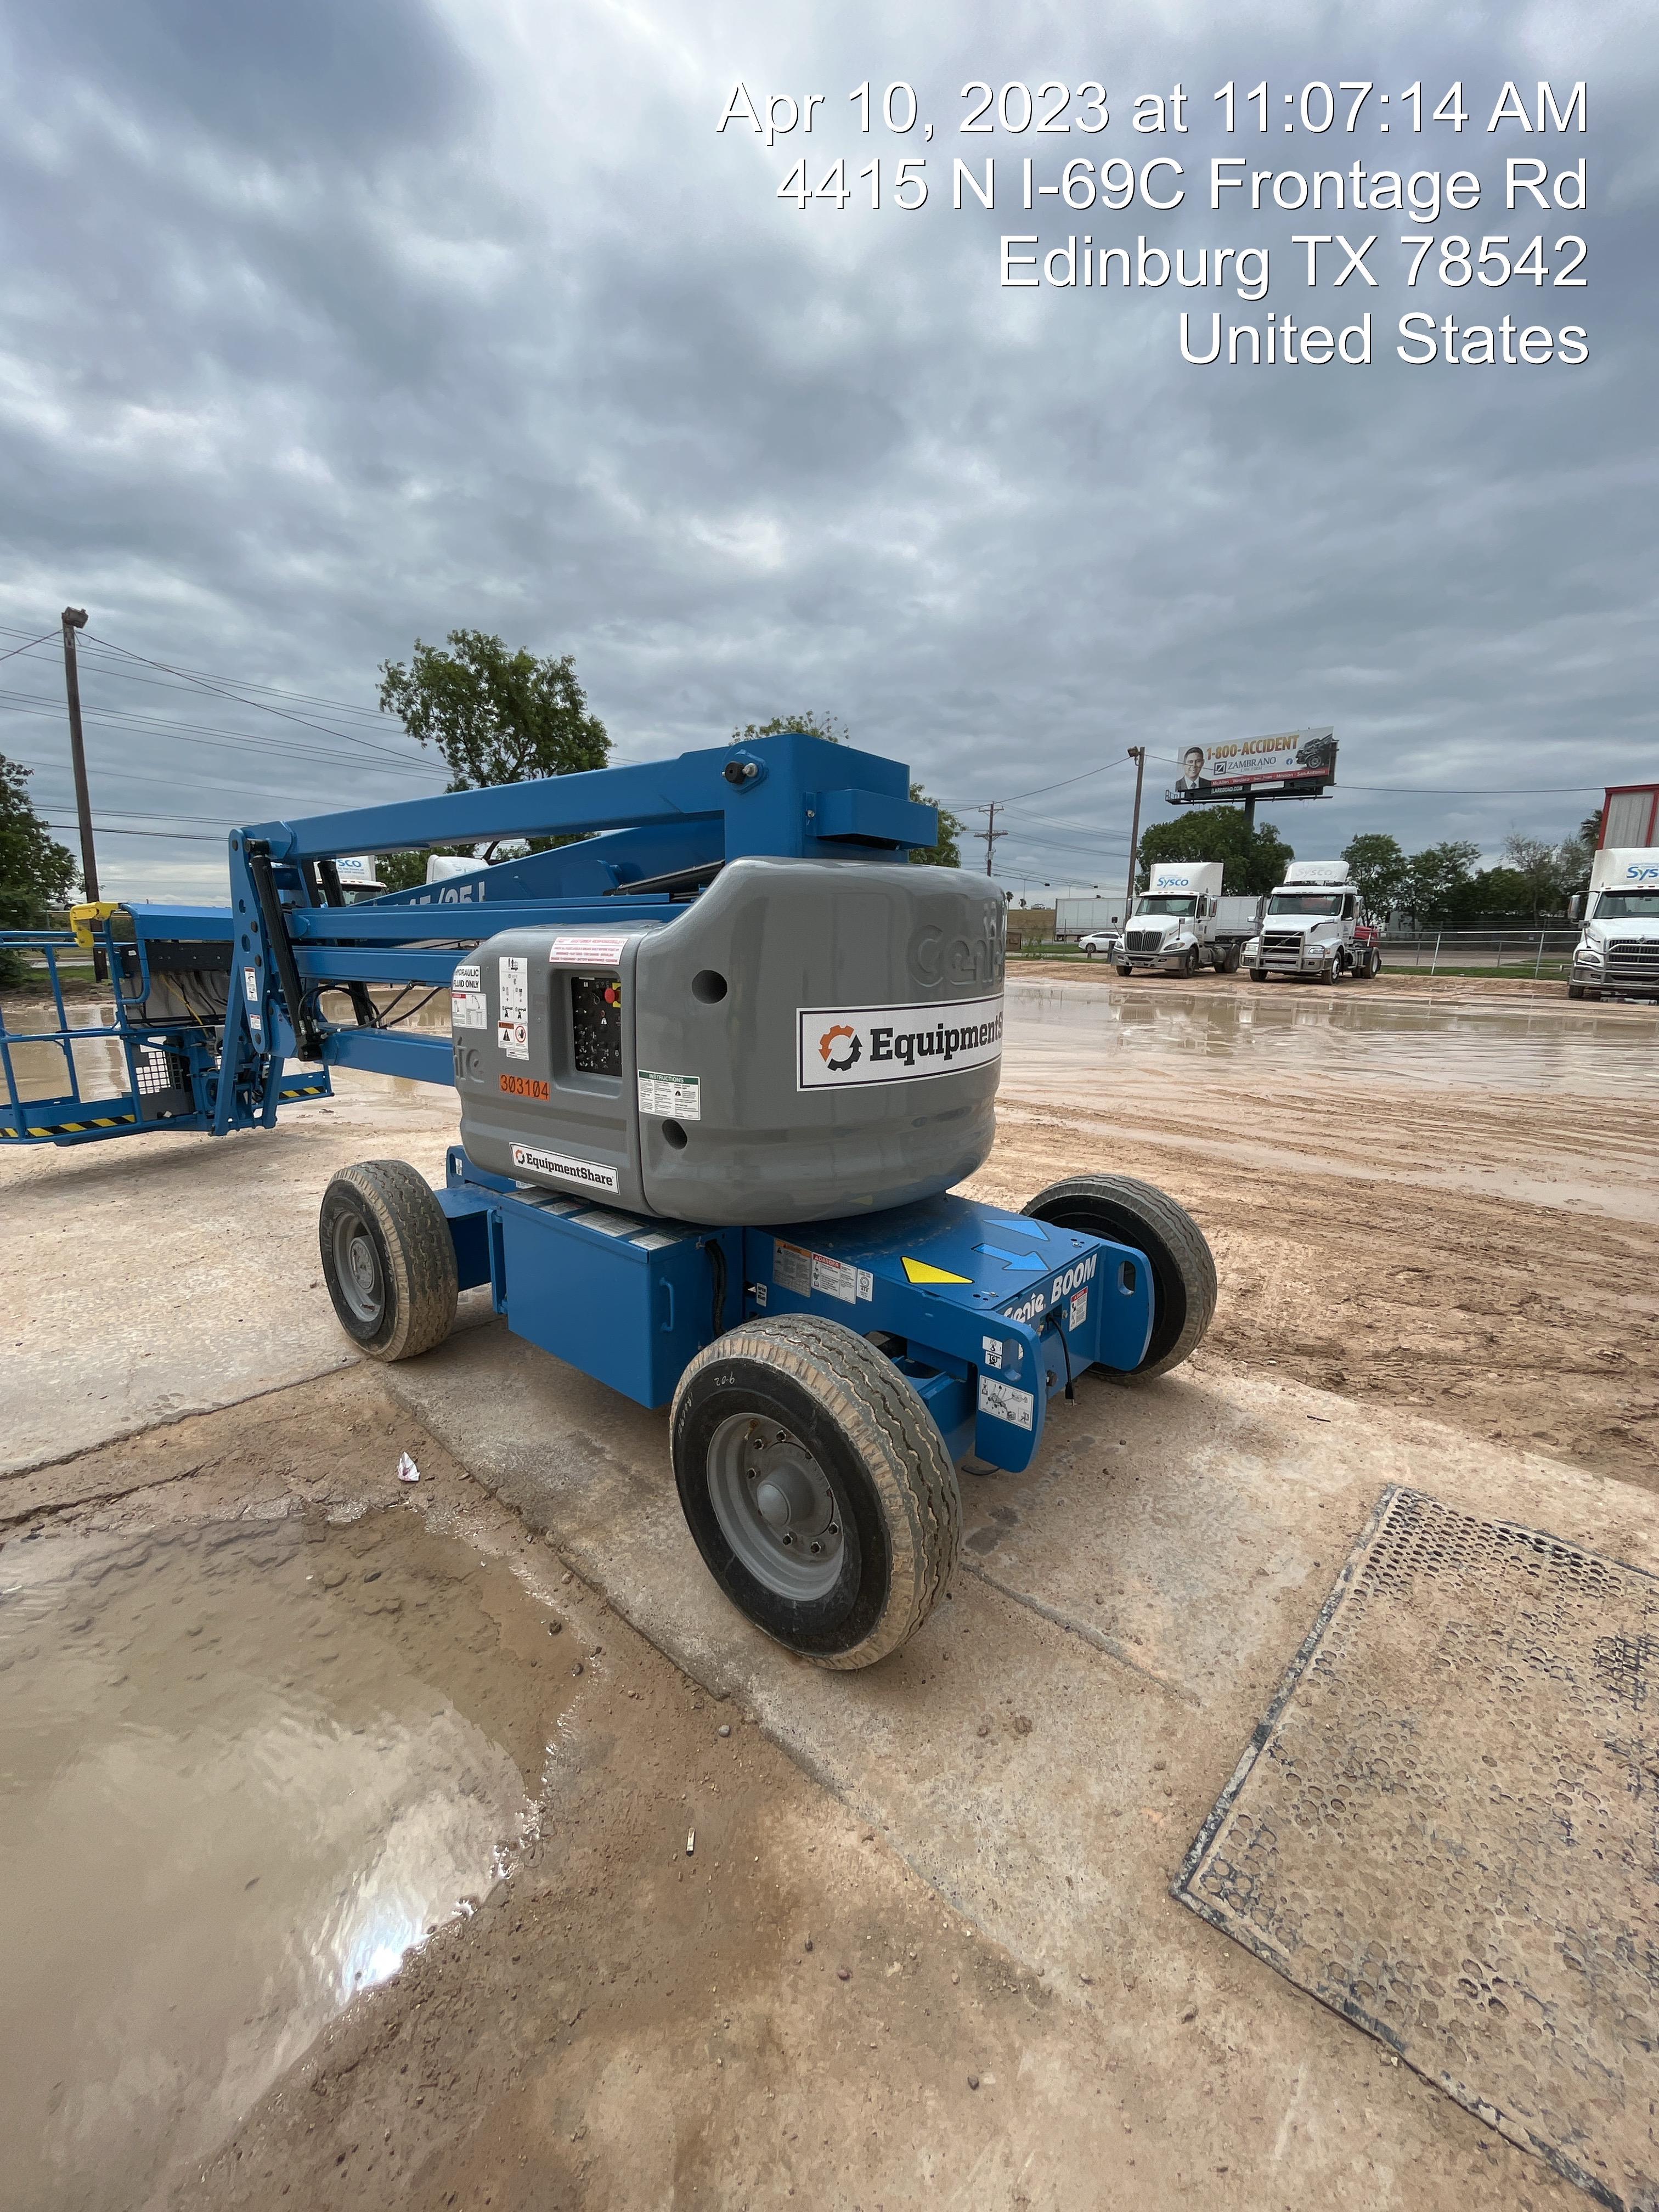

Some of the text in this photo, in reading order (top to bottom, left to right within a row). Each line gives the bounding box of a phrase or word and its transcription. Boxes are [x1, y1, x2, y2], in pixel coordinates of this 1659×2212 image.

[1207, 735, 1300, 760] 1-800-ACCIDENT
[1228, 757, 1276, 770] ZAMBRANO
[337, 859, 362, 867] sco
[1627, 866, 1659, 881] Sys
[1156, 877, 1189, 888] Sysco
[465, 980, 479, 989] ONLY
[870, 1011, 1003, 1066] EquipmentS
[649, 1074, 684, 1083] INSTRUCTIONS
[500, 1074, 549, 1098] 303104
[526, 1153, 613, 1187] EquipmentShare
[819, 1256, 839, 1268] DANGER
[1051, 1253, 1097, 1304] BOOM
